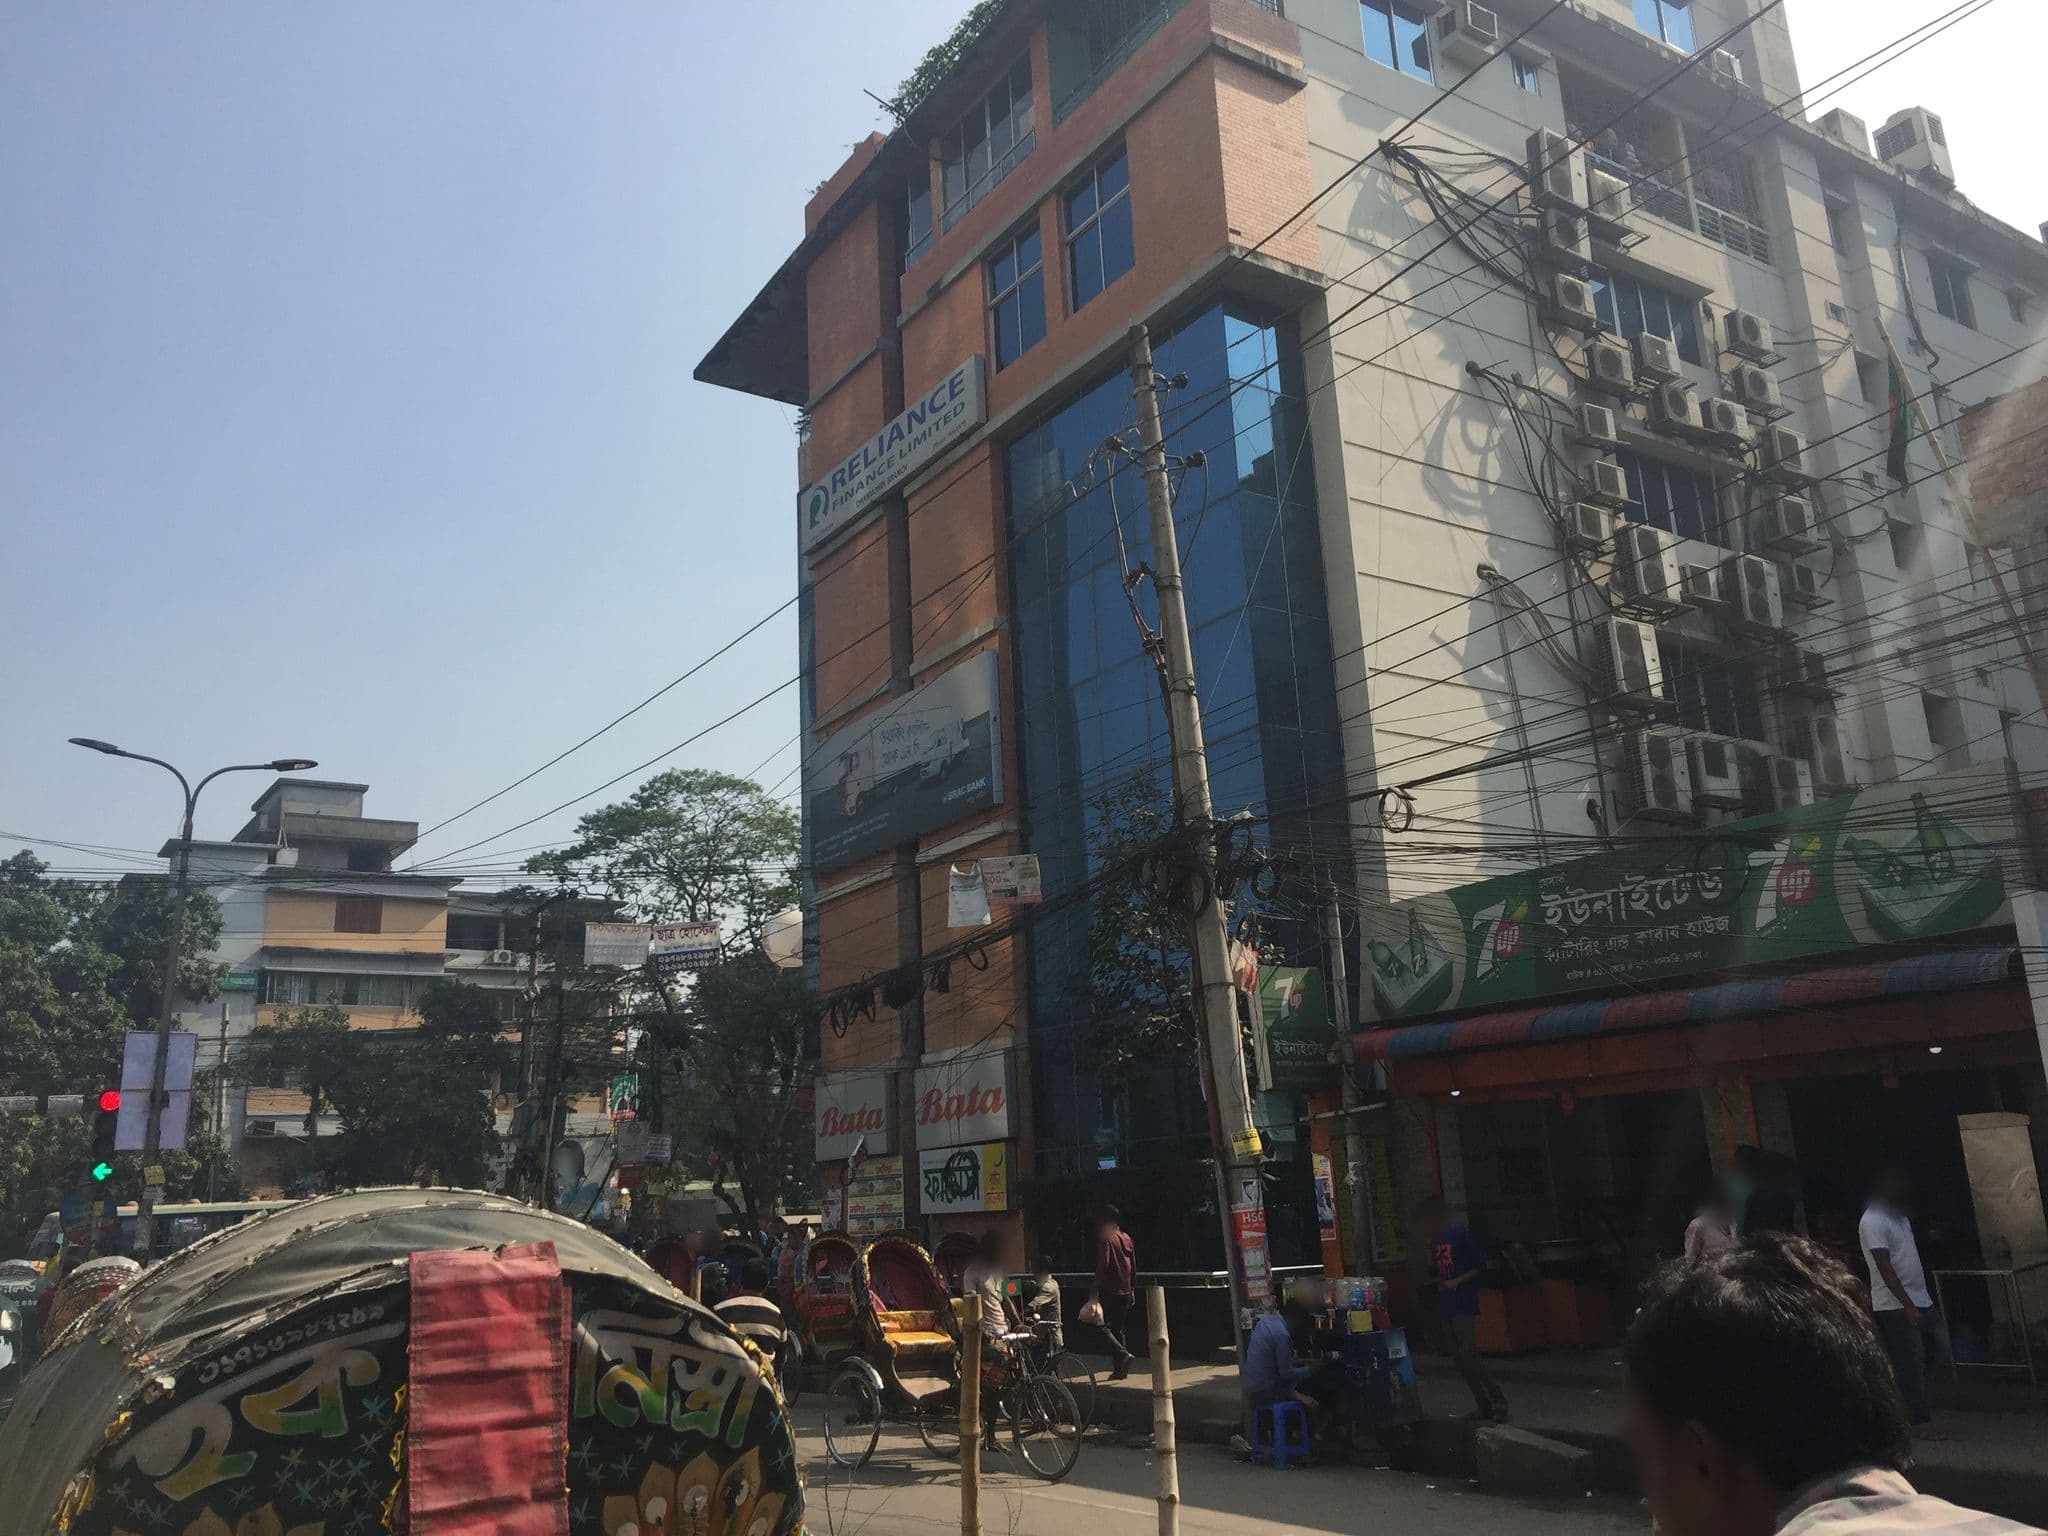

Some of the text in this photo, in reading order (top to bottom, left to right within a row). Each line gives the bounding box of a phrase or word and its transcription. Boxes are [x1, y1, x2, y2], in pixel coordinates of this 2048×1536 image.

[832, 369, 966, 495] RELIANCE
[832, 454, 896, 513] FINANCE
[898, 401, 966, 461] LIMITED
[1540, 864, 1724, 935] ইউনাইটেড
[656, 928, 676, 941] ছাত্র
[679, 924, 718, 940] হোস্টেল
[1684, 914, 1731, 938] হাউজ
[817, 1102, 885, 1138] Bata
[917, 1080, 1006, 1126] Bata
